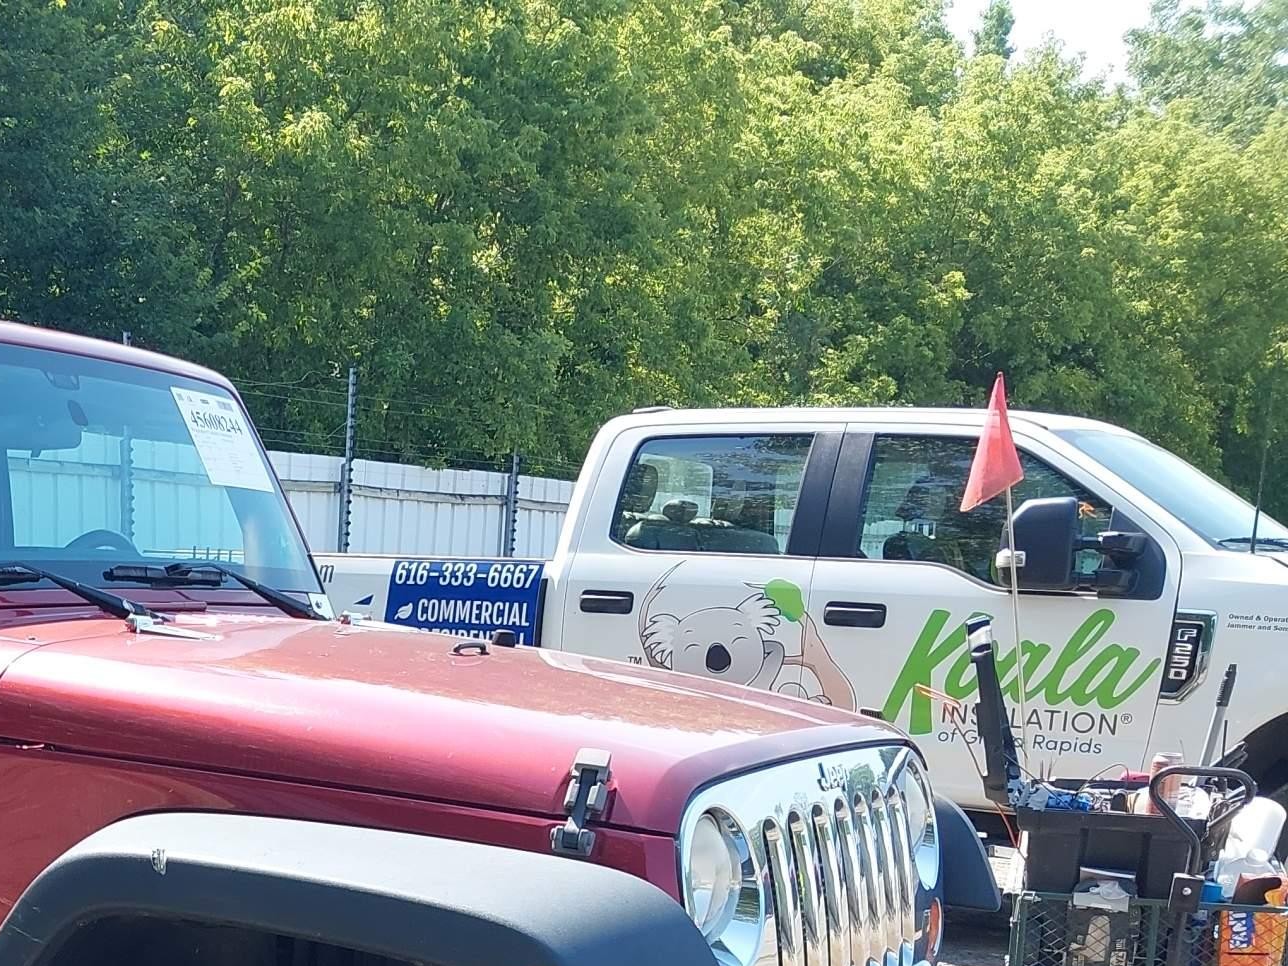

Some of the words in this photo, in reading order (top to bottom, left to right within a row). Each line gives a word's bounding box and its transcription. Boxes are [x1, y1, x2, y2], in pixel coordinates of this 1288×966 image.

[190, 409, 243, 436] 45608244
[395, 561, 540, 589] 616-333-6667
[417, 598, 530, 627] COMMERCIAL
[1228, 613, 1254, 621] Owned
[1168, 628, 1198, 681] F250
[938, 728, 959, 742] of
[1032, 734, 1102, 756] Rapids
